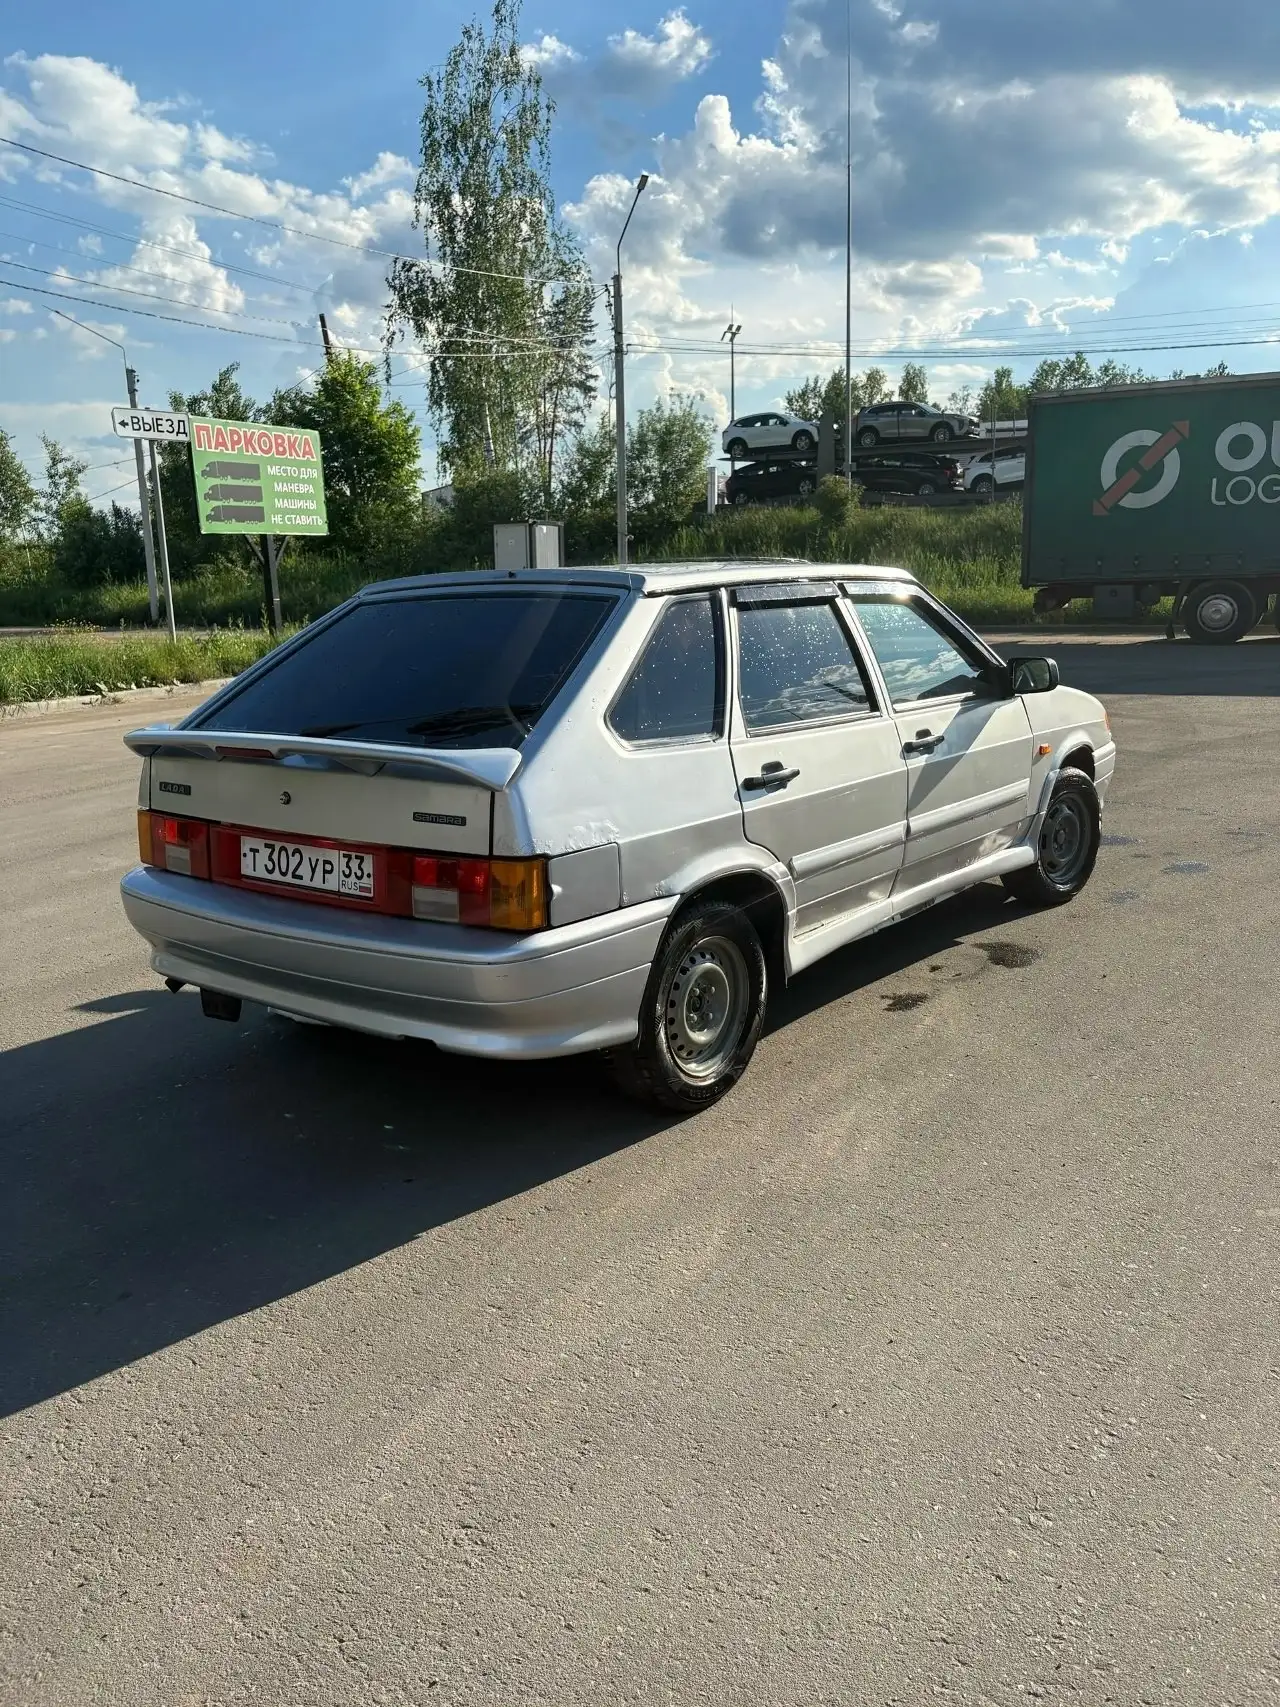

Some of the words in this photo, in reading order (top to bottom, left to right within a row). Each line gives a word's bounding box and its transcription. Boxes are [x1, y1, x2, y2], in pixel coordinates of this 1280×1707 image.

[130, 416, 188, 437] ВЫЕЗД
[194, 424, 316, 461] ПАРКОВКА
[1215, 420, 1280, 472] O
[267, 465, 298, 478] МЕСТО
[300, 467, 318, 480] ДЛЯ
[274, 482, 314, 494] МАНЕВРА
[1211, 474, 1280, 506] LOG
[274, 498, 317, 510] МАШИНЫ
[271, 514, 283, 525] НЕ
[285, 514, 323, 526] СТАВИТЬ
[161, 783, 185, 793] LADA
[342, 853, 365, 881] 33
[341, 879, 359, 891] RUS
